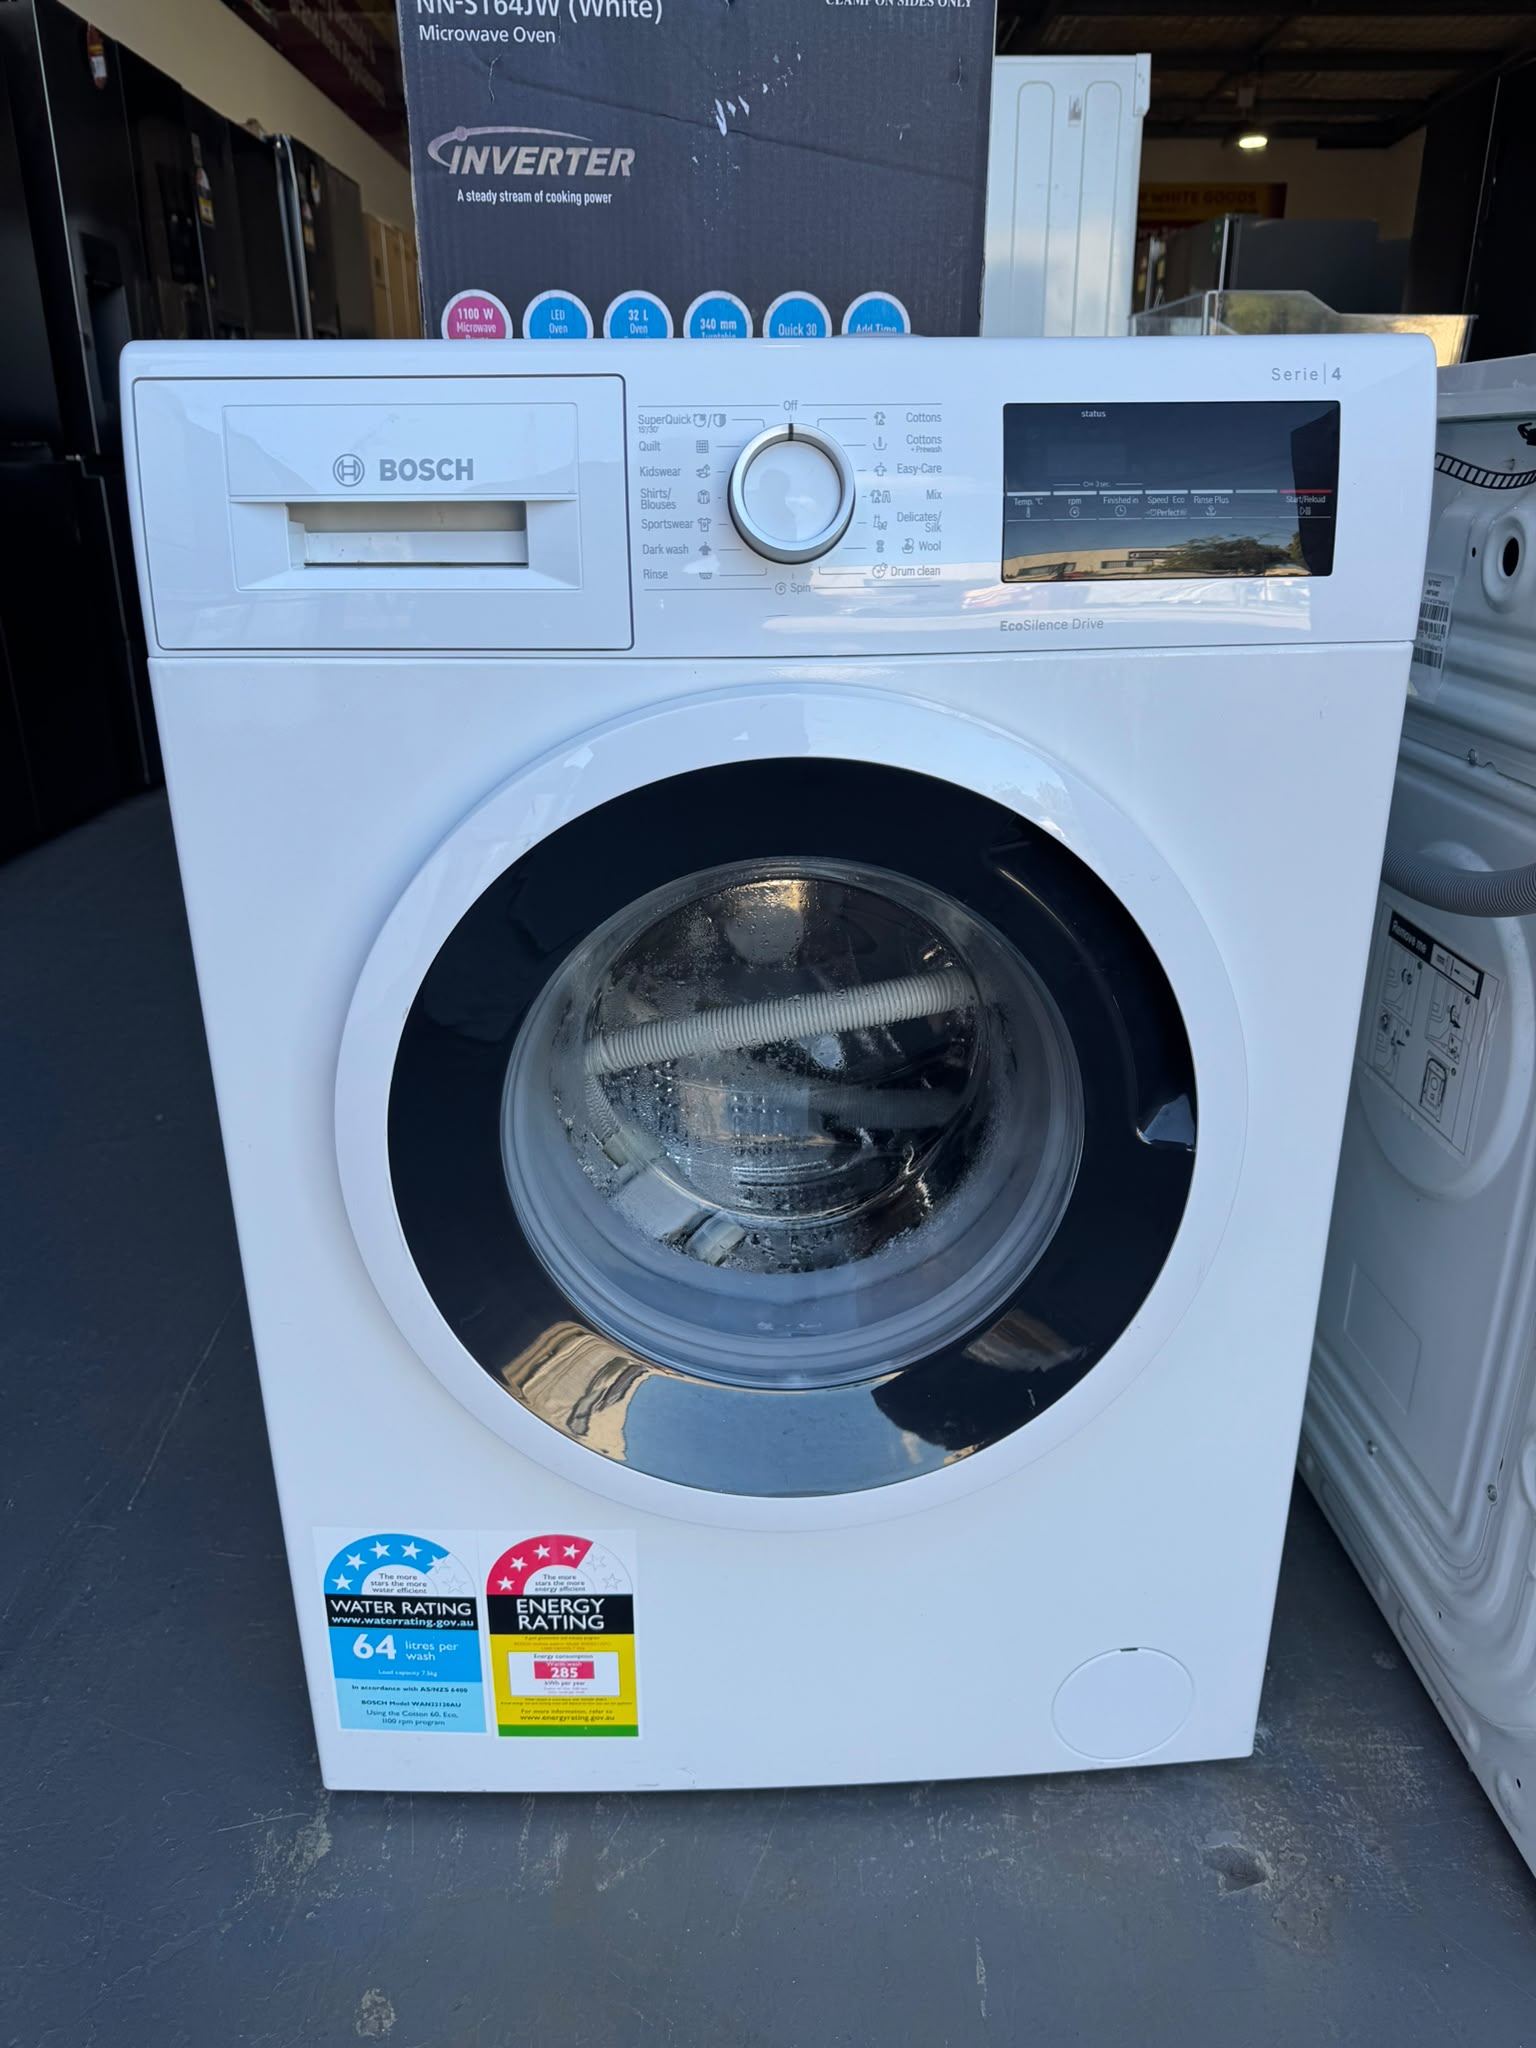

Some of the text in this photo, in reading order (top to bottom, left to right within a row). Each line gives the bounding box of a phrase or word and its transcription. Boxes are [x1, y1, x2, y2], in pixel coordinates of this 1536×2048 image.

[569, 0, 663, 24] (White)
[419, 25, 556, 43] Microwave Oven
[448, 145, 636, 177] INVERTER
[457, 189, 613, 206] A steady stream of cooking power
[457, 308, 494, 320] 1100 W
[551, 309, 565, 320] LED
[628, 309, 648, 321] 32 L
[456, 321, 496, 334] Microwave
[549, 322, 568, 334] Oven
[630, 322, 648, 334] Oven
[700, 318, 737, 330] 340 mm
[778, 323, 817, 336] Quick 30
[783, 400, 799, 412] Off
[906, 412, 942, 423] Cottons
[1081, 409, 1107, 418] status
[638, 413, 692, 428] SuperQuick
[906, 434, 942, 445] Cottons
[638, 441, 662, 452] Quilt
[916, 445, 942, 453] Prewash
[379, 458, 474, 482] BOSCH
[639, 466, 681, 478] Kidswear
[896, 462, 942, 476] Easy-Care
[640, 488, 672, 500] Shirts/
[926, 489, 942, 500] Mix
[1103, 496, 1139, 504] Finished in
[1194, 496, 1230, 504] Rinse Plus
[640, 500, 677, 510] Blouses
[1068, 498, 1082, 506] rpm
[1147, 496, 1185, 505] Speed Eco
[896, 510, 942, 524] Delicates/
[641, 518, 694, 531] Sportswear
[924, 522, 942, 533] Silk
[642, 544, 689, 556] Dark wash
[918, 540, 942, 552] Wool
[643, 569, 668, 580] Rinse
[890, 565, 941, 576] Drum clean
[790, 583, 811, 594] Spin
[1000, 618, 1104, 632] EcoSilence Drive
[378, 1572, 395, 1580] The
[391, 1580, 404, 1588] the
[330, 1600, 472, 1616] WATER RATING
[516, 1598, 606, 1615] ENERGY
[331, 1616, 475, 1628] www.waterrating.gov.au
[518, 1614, 605, 1631] RATING
[352, 1633, 397, 1660] 64
[405, 1640, 459, 1652] litres per
[406, 1652, 436, 1661] wash
[550, 1667, 579, 1678] 285
[366, 1709, 386, 1718] Using
